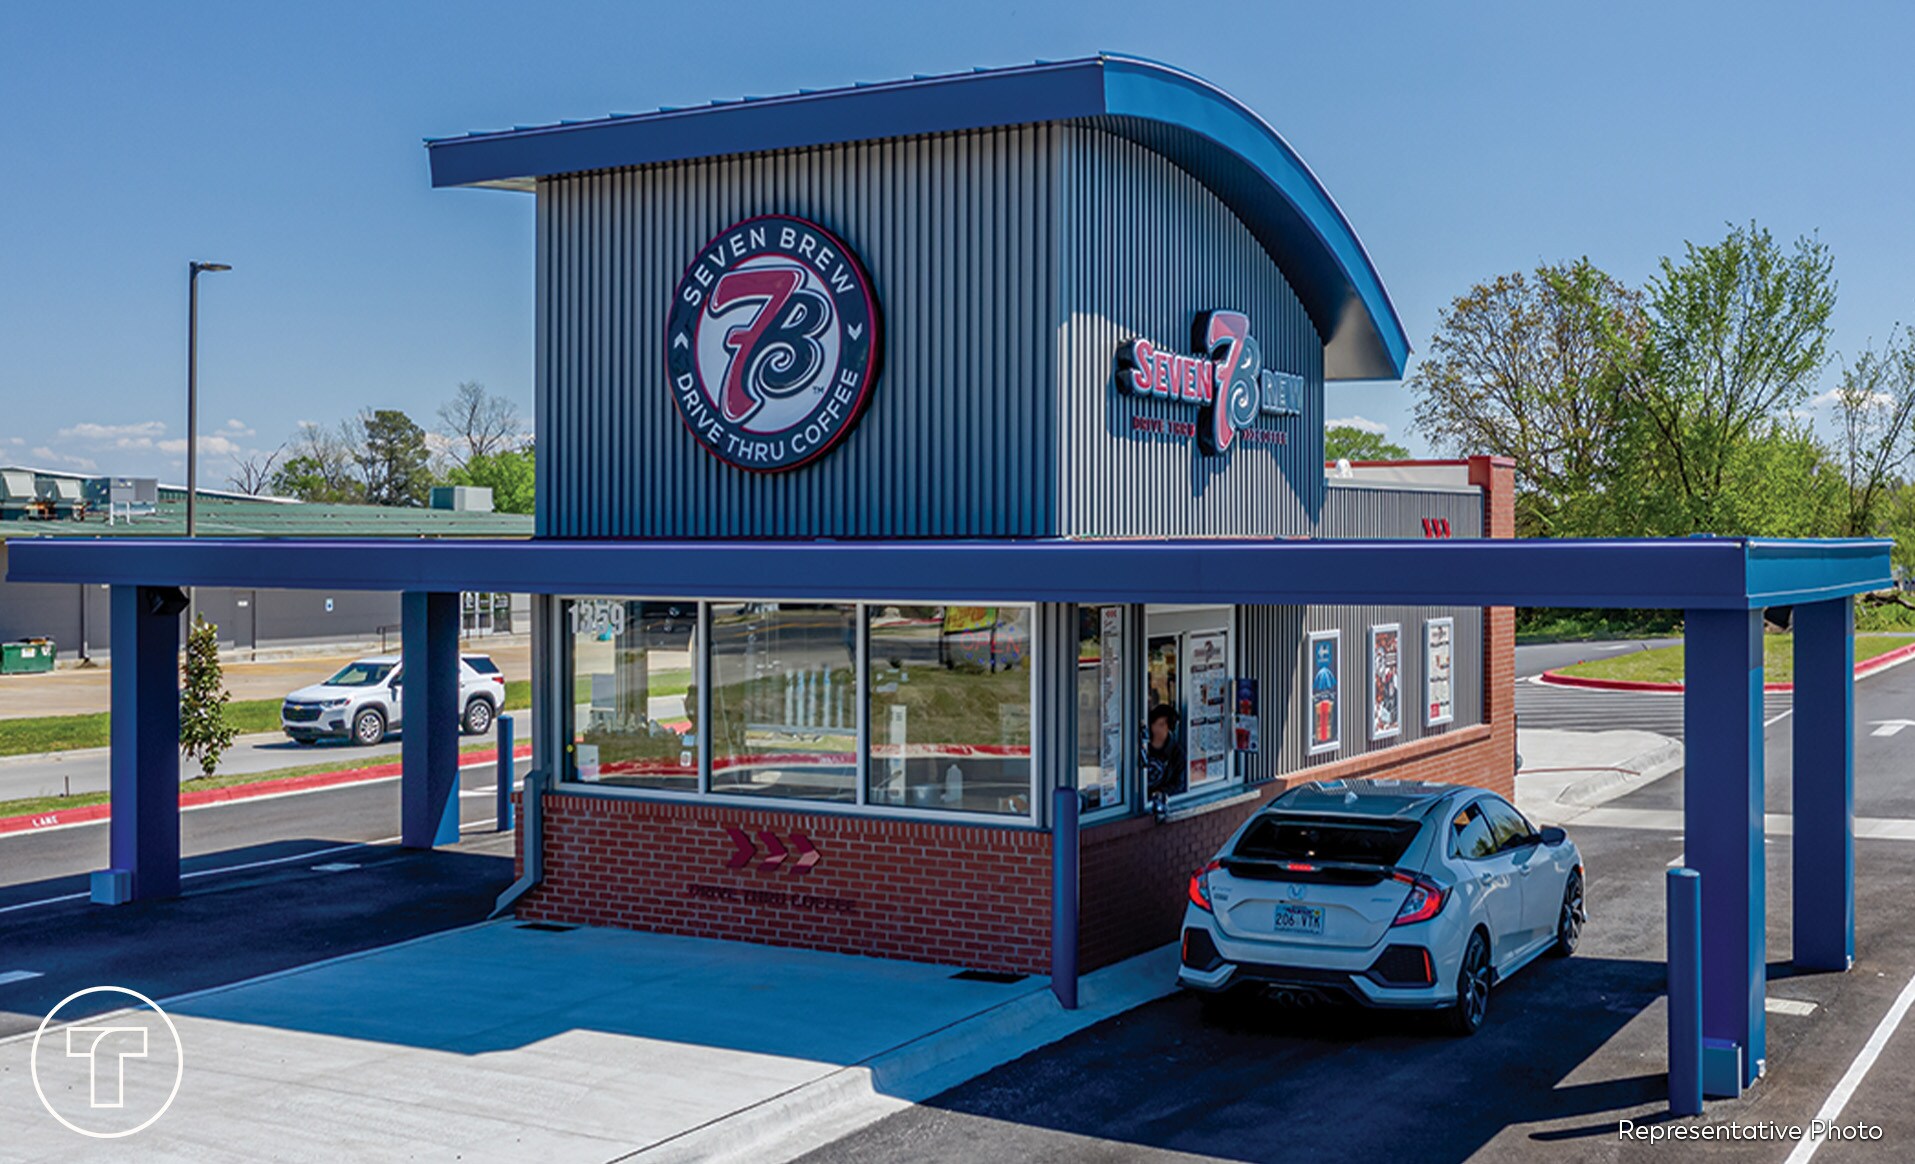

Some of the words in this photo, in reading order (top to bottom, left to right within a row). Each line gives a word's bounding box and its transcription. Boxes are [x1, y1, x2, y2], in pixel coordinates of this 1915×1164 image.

[683, 227, 766, 306] SEVEN
[780, 227, 855, 294] BREW
[1132, 338, 1213, 402] SEVEN
[677, 372, 725, 444] DRIVE
[726, 433, 784, 462] THRU
[791, 368, 859, 453] COFFEE
[1133, 415, 1164, 434] DRIVE
[568, 603, 625, 635] 1359
[960, 631, 1022, 654] OPEN
[32, 815, 59, 828] LANE
[1275, 912, 1296, 927] 206
